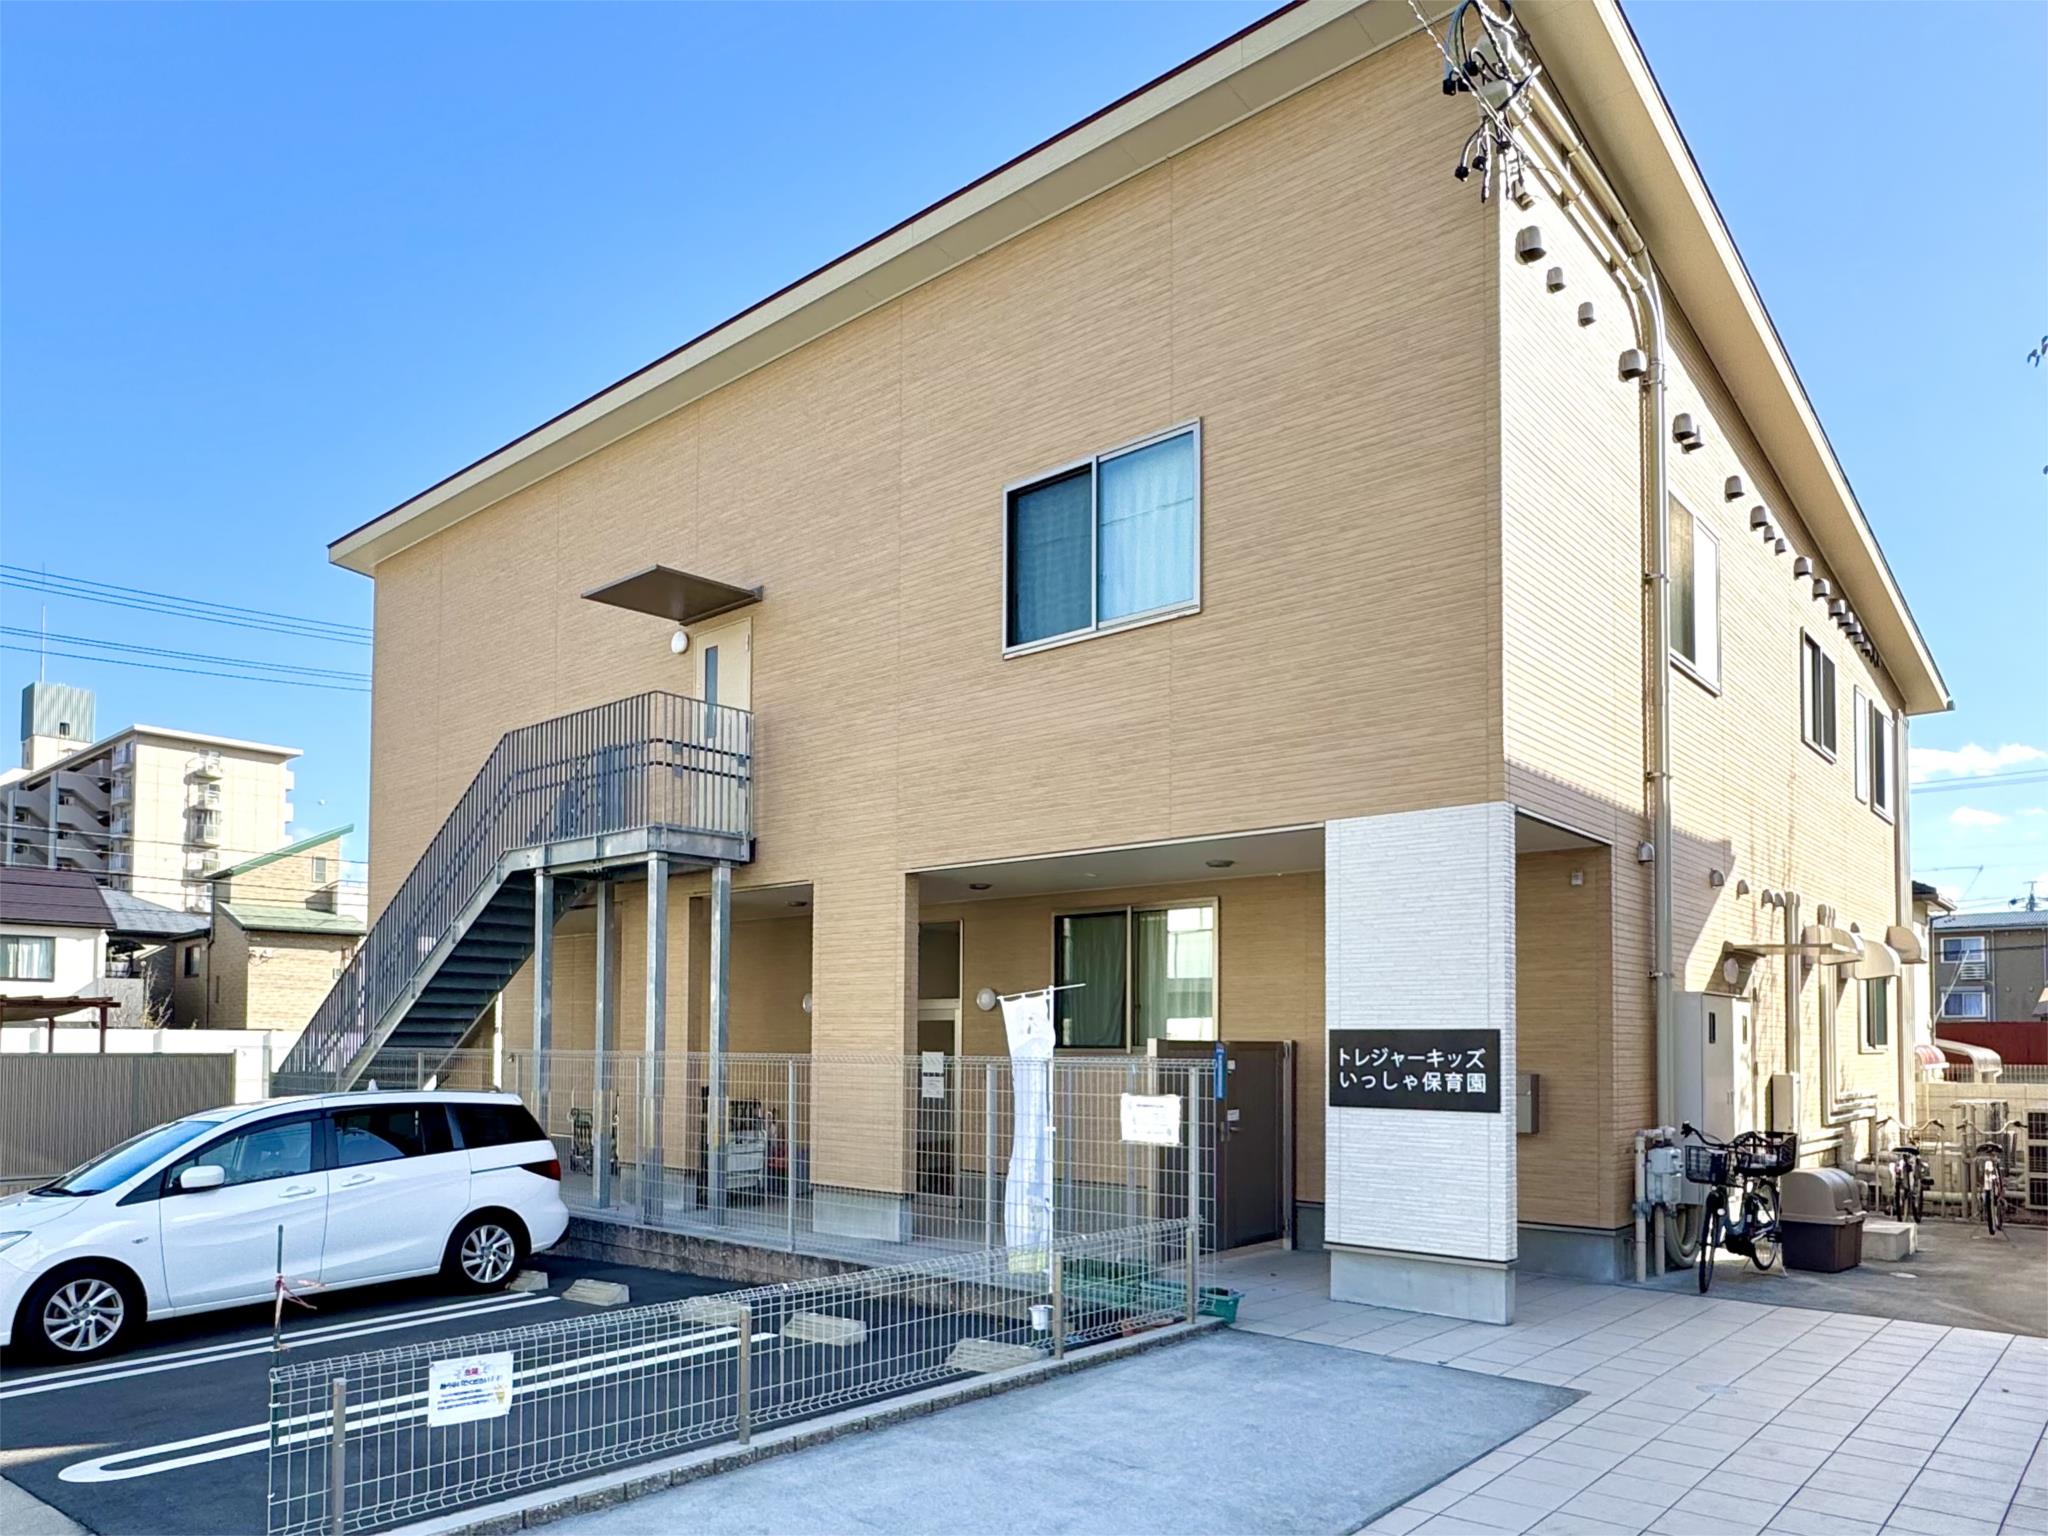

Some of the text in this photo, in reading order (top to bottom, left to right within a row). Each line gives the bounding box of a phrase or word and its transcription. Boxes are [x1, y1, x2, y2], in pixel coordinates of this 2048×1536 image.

[1339, 1047, 1486, 1069] トレジャーキッズ
[1339, 1071, 1487, 1094] いっしゃ保育園
